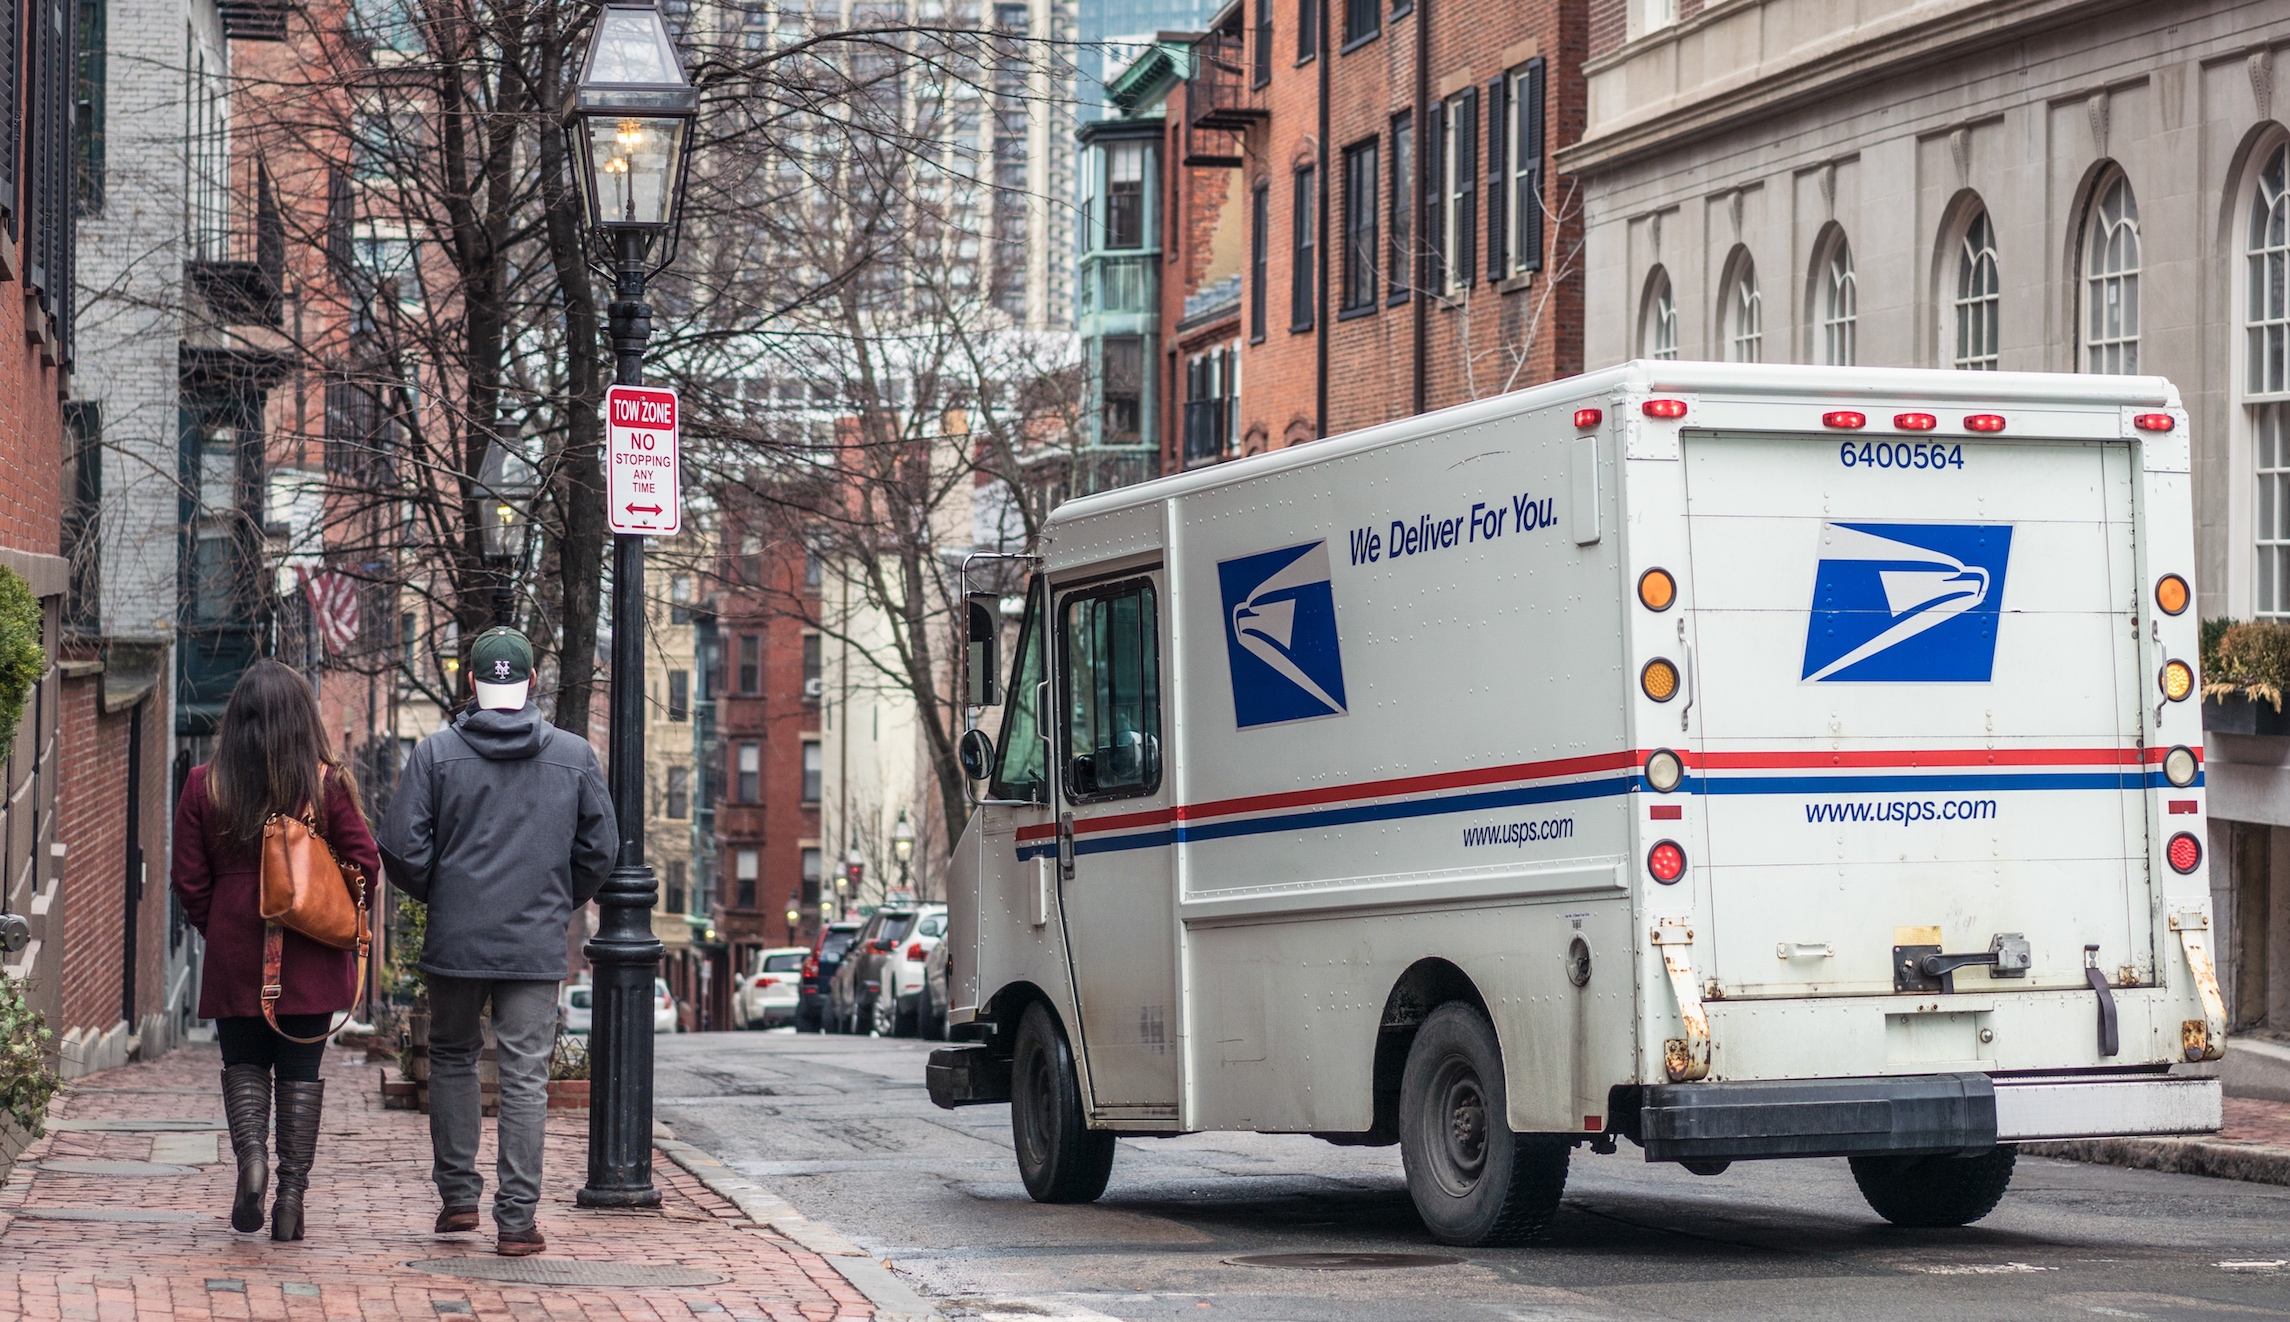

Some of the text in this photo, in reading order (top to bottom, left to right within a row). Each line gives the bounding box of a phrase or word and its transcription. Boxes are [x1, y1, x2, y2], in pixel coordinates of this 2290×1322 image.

[614, 399, 671, 424] TOW ZONE
[631, 433, 655, 450] NO
[616, 453, 671, 467] STOPPING
[1840, 441, 1964, 469] 6400564
[633, 470, 654, 480] ANY
[633, 482, 655, 493] TIME
[1350, 493, 1558, 566] We Deliver For You.
[1805, 800, 1997, 827] www.usps.com
[1463, 818, 1573, 848] www.usps.com
